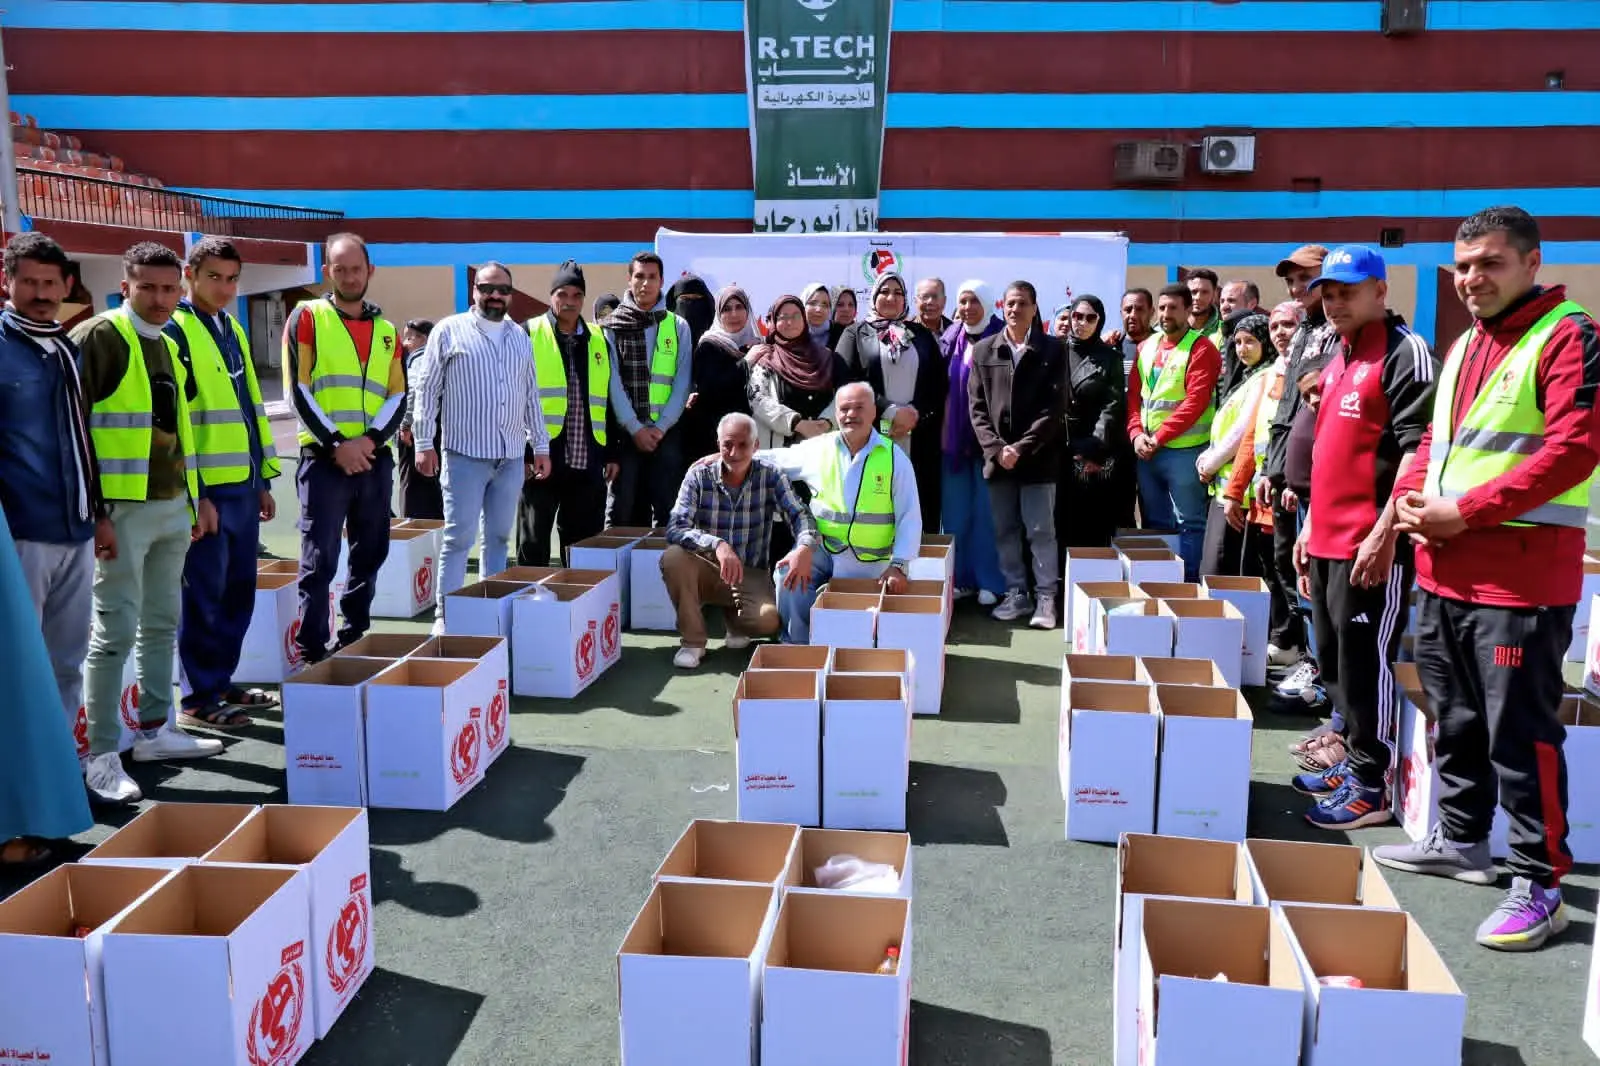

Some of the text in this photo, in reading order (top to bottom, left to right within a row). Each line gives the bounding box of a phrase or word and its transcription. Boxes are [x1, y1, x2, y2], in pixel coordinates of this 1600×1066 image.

[757, 35, 875, 59] R.TECH
[757, 60, 875, 82] الرحاب
[763, 89, 824, 107] الكهربائية
[786, 162, 856, 187] الأستاذ
